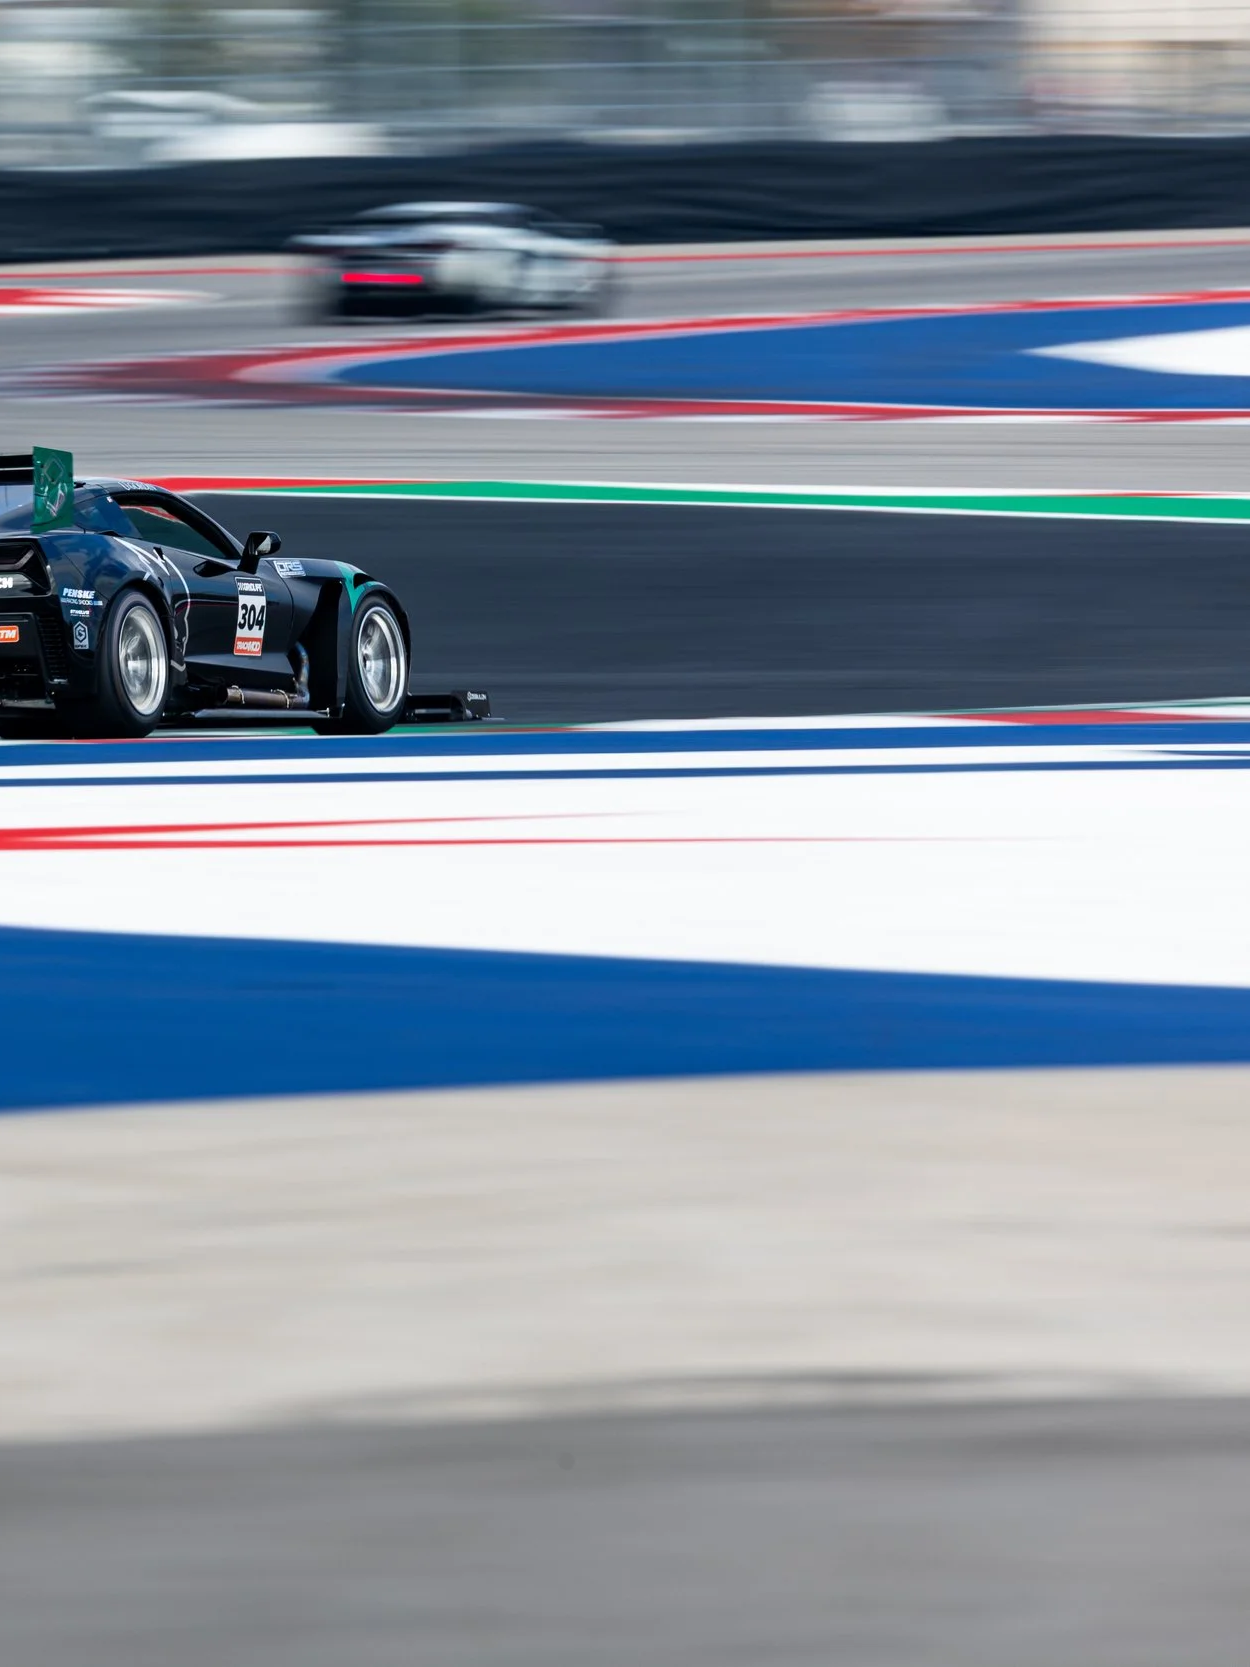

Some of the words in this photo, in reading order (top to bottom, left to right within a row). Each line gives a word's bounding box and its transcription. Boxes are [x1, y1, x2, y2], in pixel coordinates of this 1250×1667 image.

[62, 588, 96, 599] PENSKE
[238, 603, 266, 631] 304
[0, 629, 17, 639] TM
